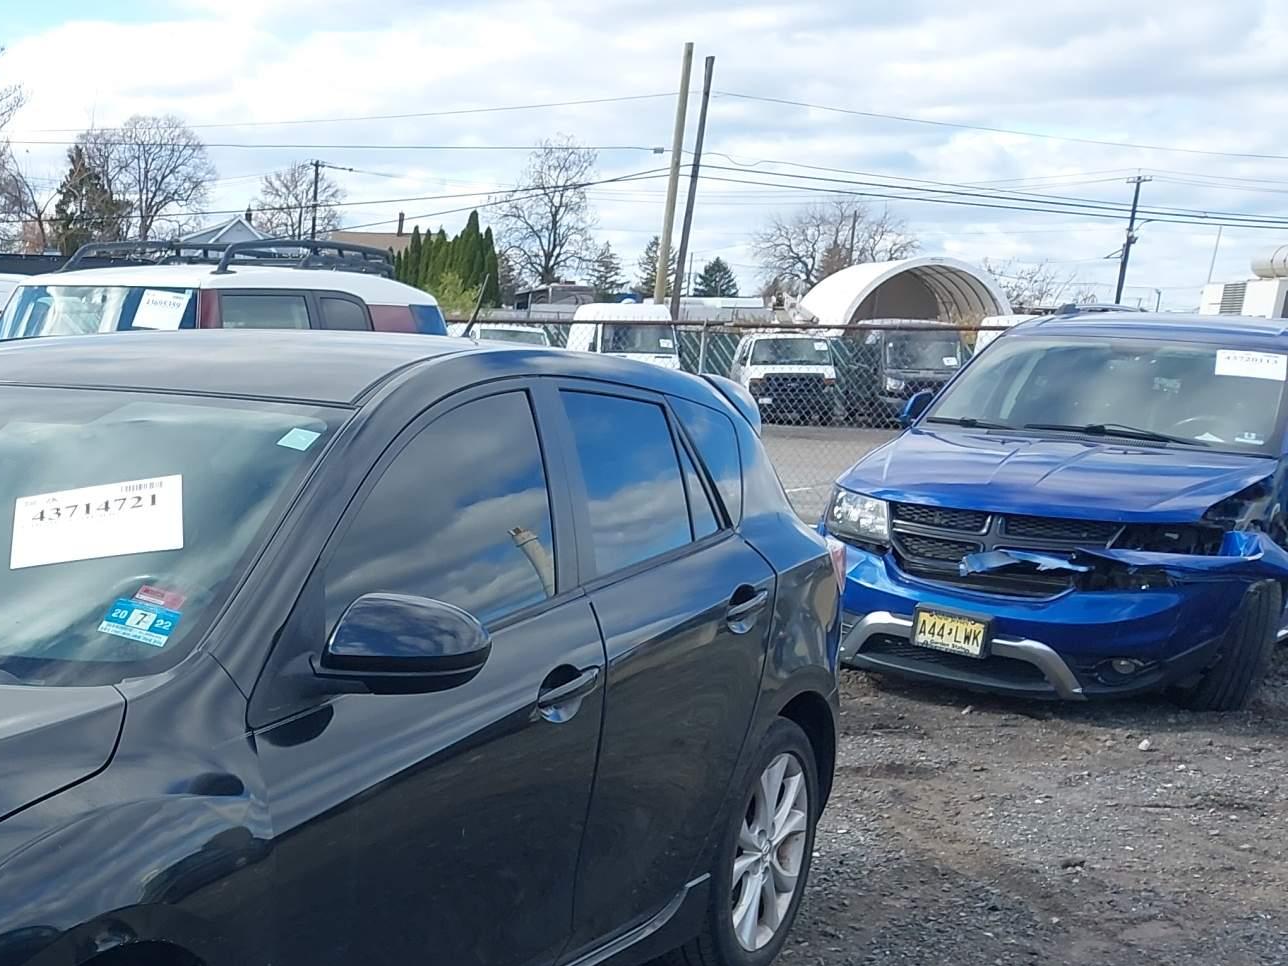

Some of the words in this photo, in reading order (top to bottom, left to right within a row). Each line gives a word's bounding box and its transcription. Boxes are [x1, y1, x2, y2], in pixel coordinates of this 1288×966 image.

[31, 493, 158, 522] 43714721
[111, 608, 129, 619] 20
[135, 612, 148, 626] 7
[155, 619, 172, 630] 22
